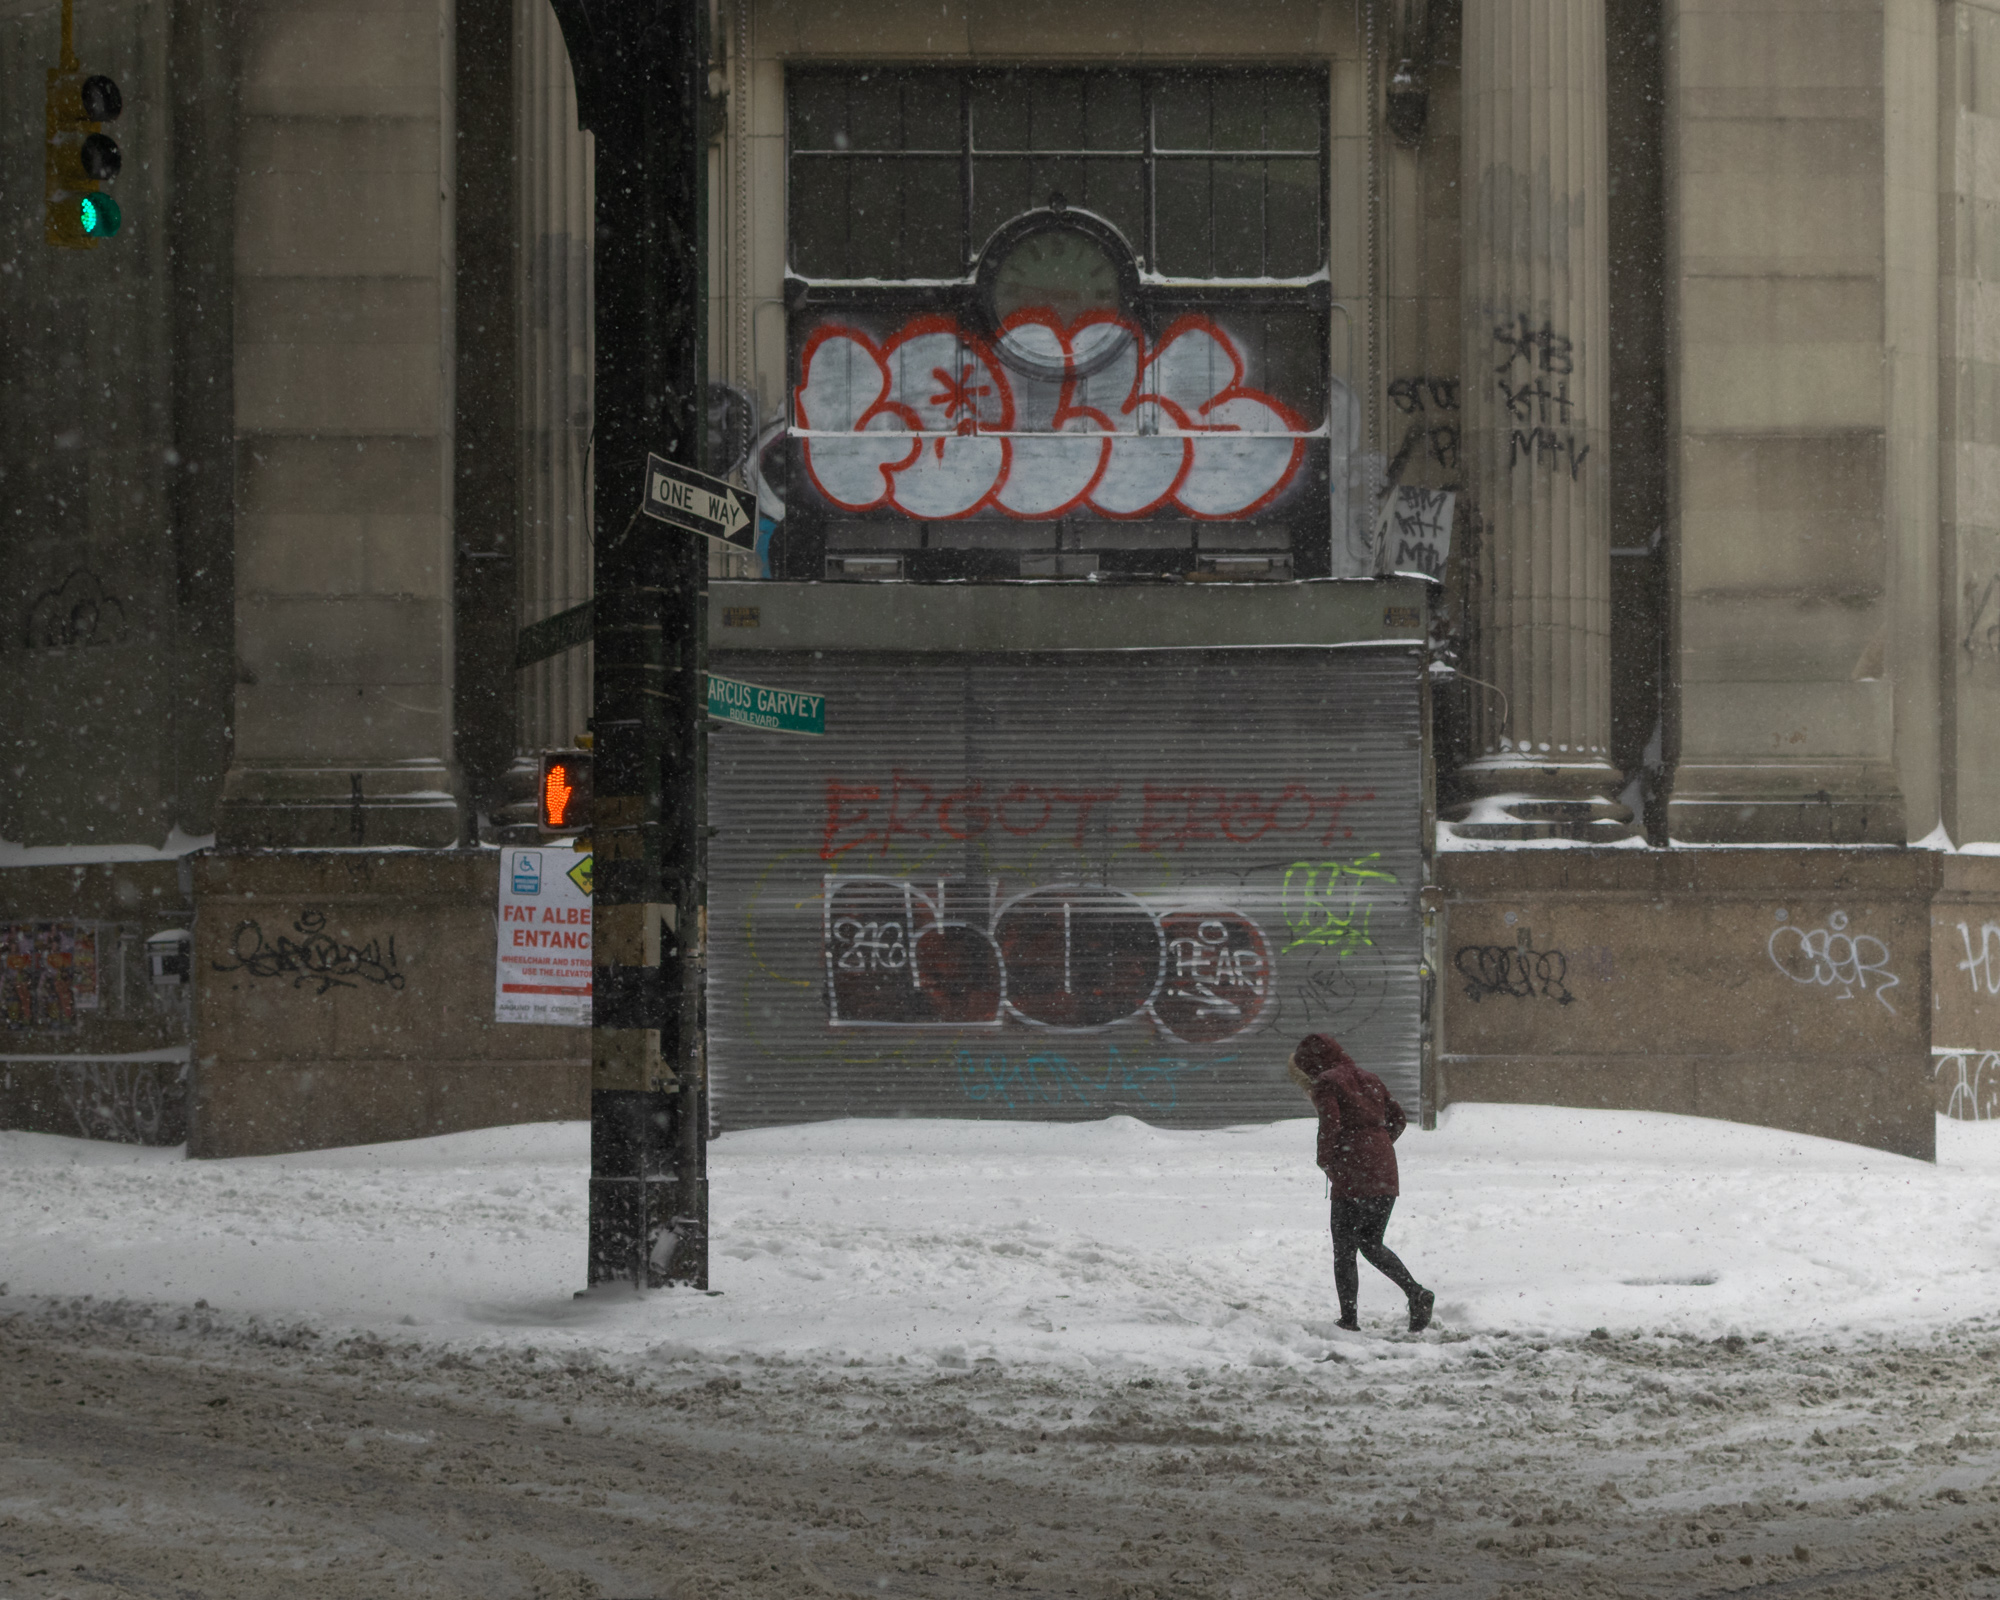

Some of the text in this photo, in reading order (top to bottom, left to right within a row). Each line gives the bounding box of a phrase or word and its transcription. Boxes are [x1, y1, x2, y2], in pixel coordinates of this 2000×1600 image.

[659, 479, 740, 526] ONE WAY
[708, 678, 820, 718] ARCUS GARVEY
[729, 708, 779, 728] BOULEVARD
[503, 905, 591, 925] FAT ALBE
[513, 930, 592, 949] ENTANC
[502, 955, 551, 964] WHEELCHAIR
[552, 958, 568, 966] AND
[522, 967, 537, 976] USE
[539, 968, 554, 976] THE
